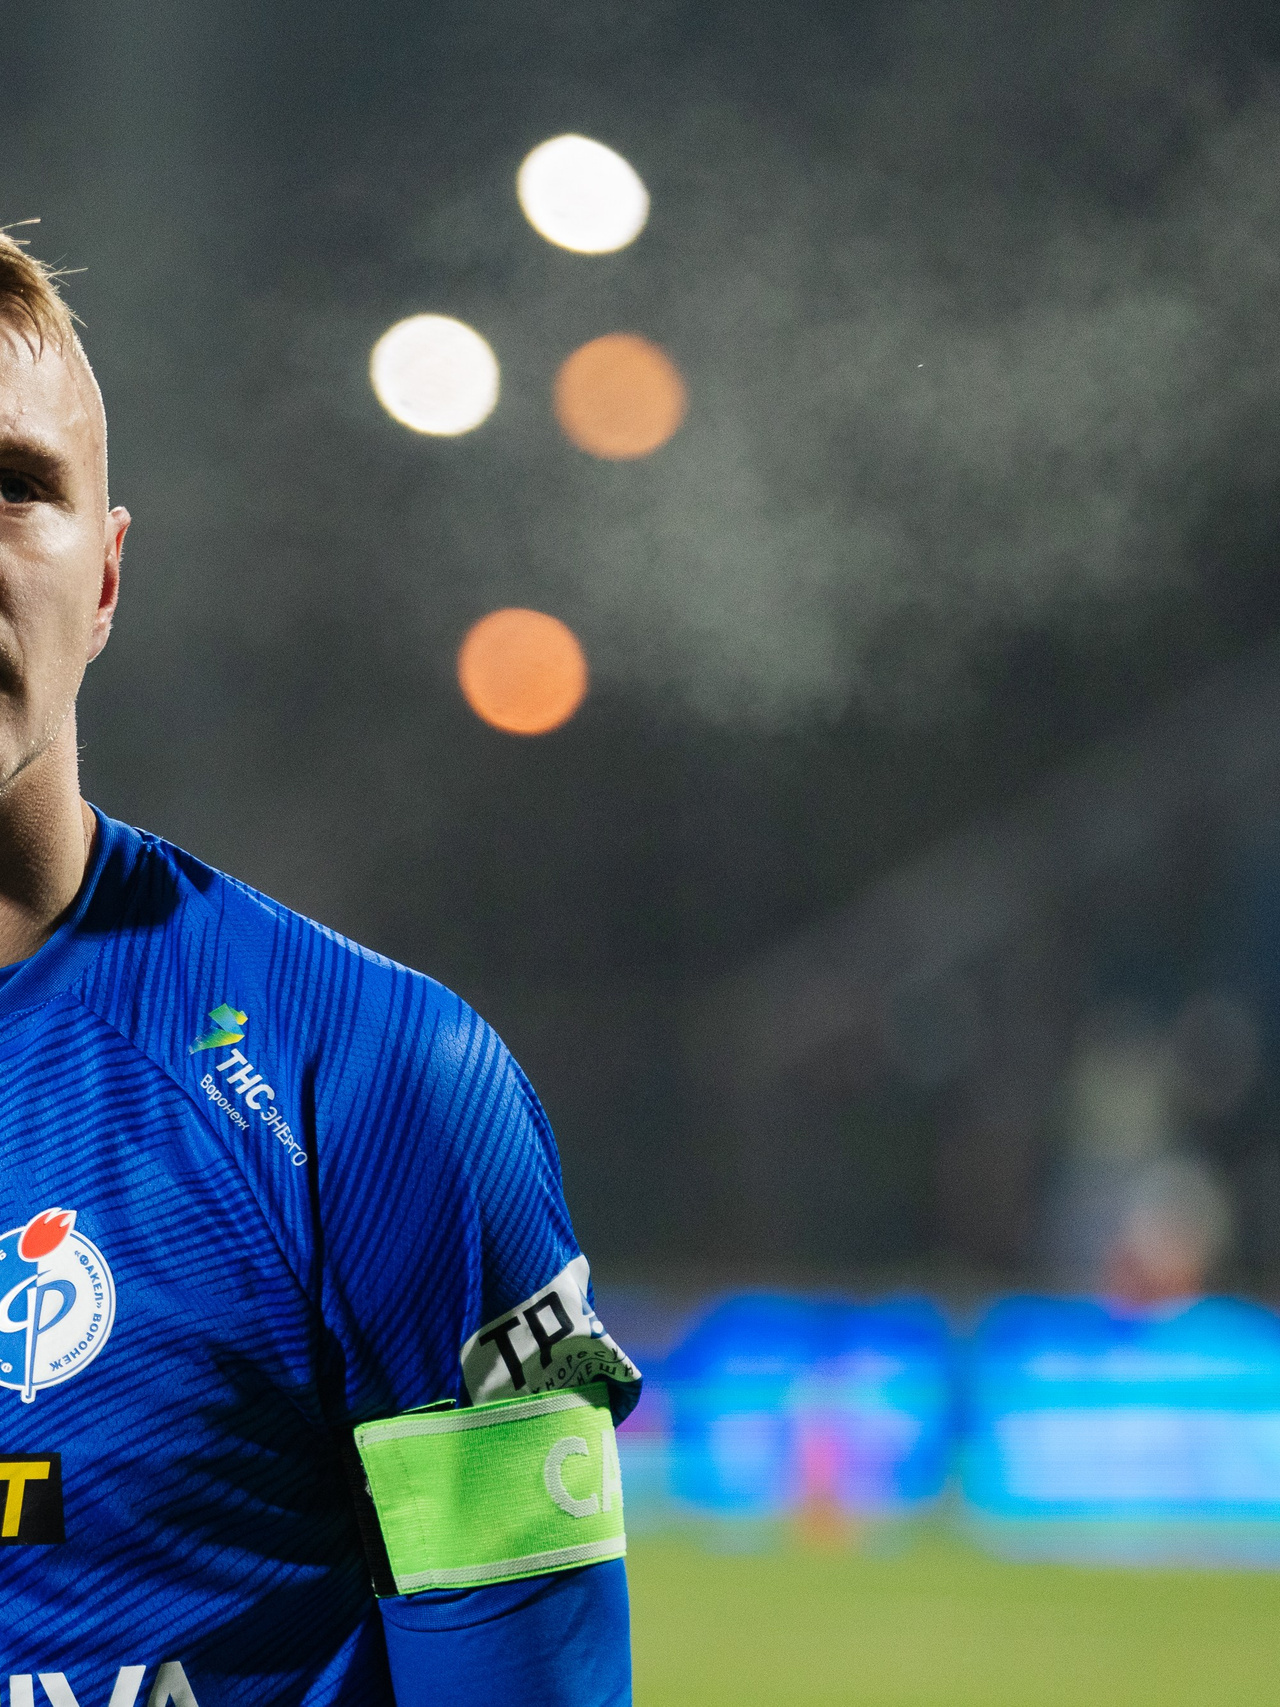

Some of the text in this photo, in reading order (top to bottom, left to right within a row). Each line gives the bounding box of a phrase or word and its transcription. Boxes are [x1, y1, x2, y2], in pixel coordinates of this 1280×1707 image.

[199, 1073, 250, 1131] Воронеж
[216, 1048, 308, 1167] ТНС ЭНЕРГО
[49, 1313, 103, 1372] ВОРОНЕЖ
